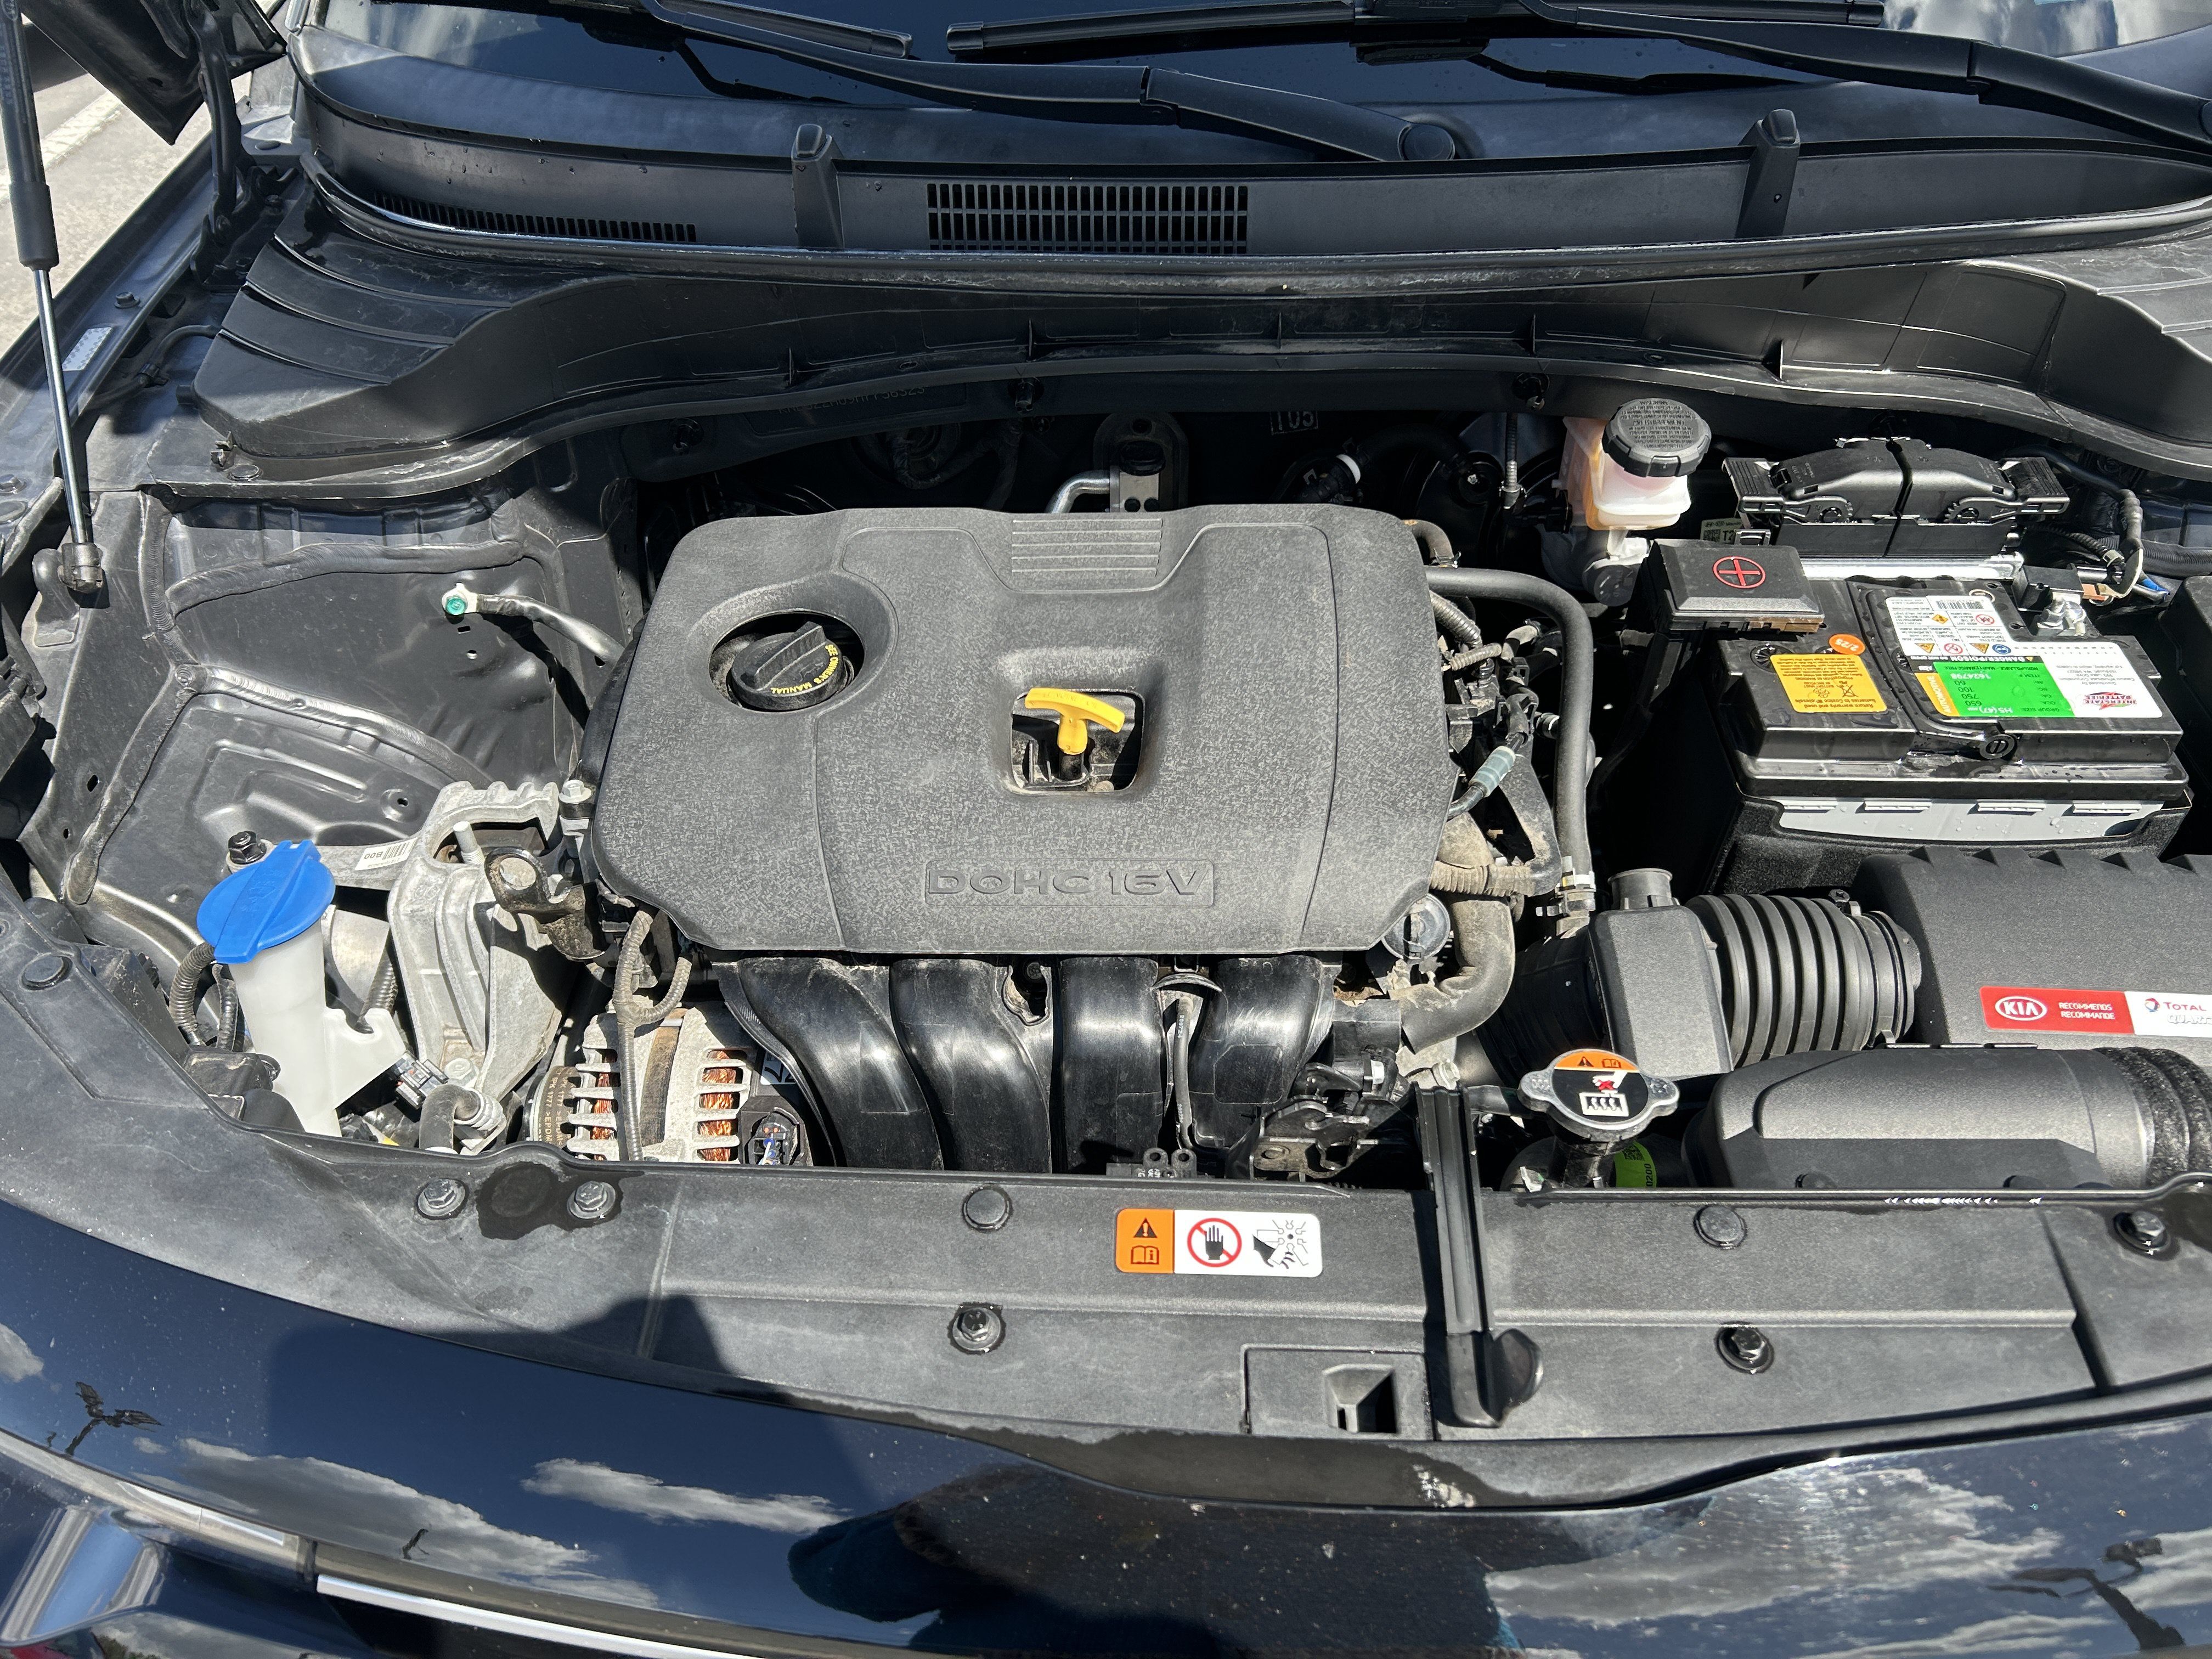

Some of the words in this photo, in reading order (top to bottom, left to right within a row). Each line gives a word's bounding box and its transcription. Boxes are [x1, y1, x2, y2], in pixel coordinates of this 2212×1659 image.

[825, 644, 834, 657] SEE
[1835, 638, 1860, 652] 2/25
[813, 657, 839, 684] OWNER'S
[770, 682, 813, 695] MANUAL
[1927, 675, 1952, 714] AUTOMOTIVE
[928, 869, 1095, 896] DOHC
[1108, 869, 1210, 896] 16V
[2003, 1001, 2040, 1017] KIA
[2058, 1002, 2113, 1012] RECOMMENDS
[2163, 1002, 2207, 1012] TOTAL
[2060, 1011, 2116, 1020] RECOMMANDE
